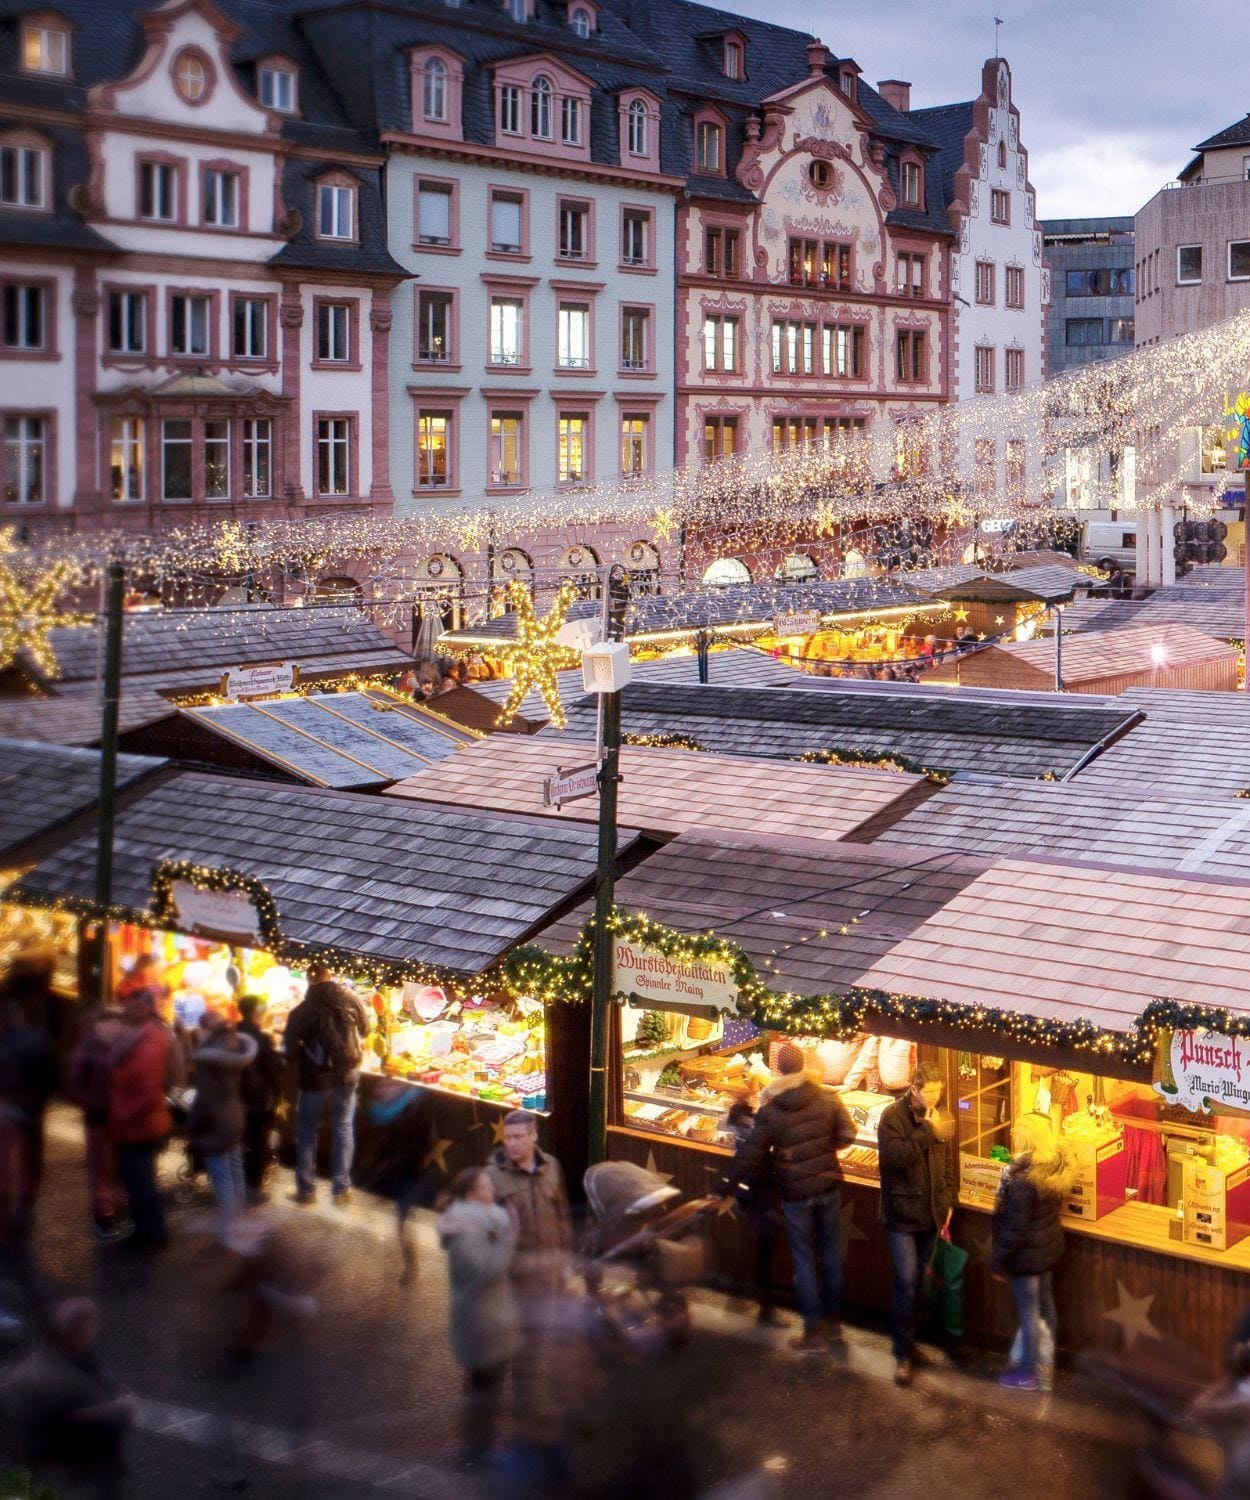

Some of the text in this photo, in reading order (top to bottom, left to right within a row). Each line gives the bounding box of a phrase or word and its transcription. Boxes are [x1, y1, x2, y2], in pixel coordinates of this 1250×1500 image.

[675, 979, 704, 999] Mainz
[1180, 1028, 1242, 1081] Punsch
[1189, 1075, 1220, 1094] Mario
